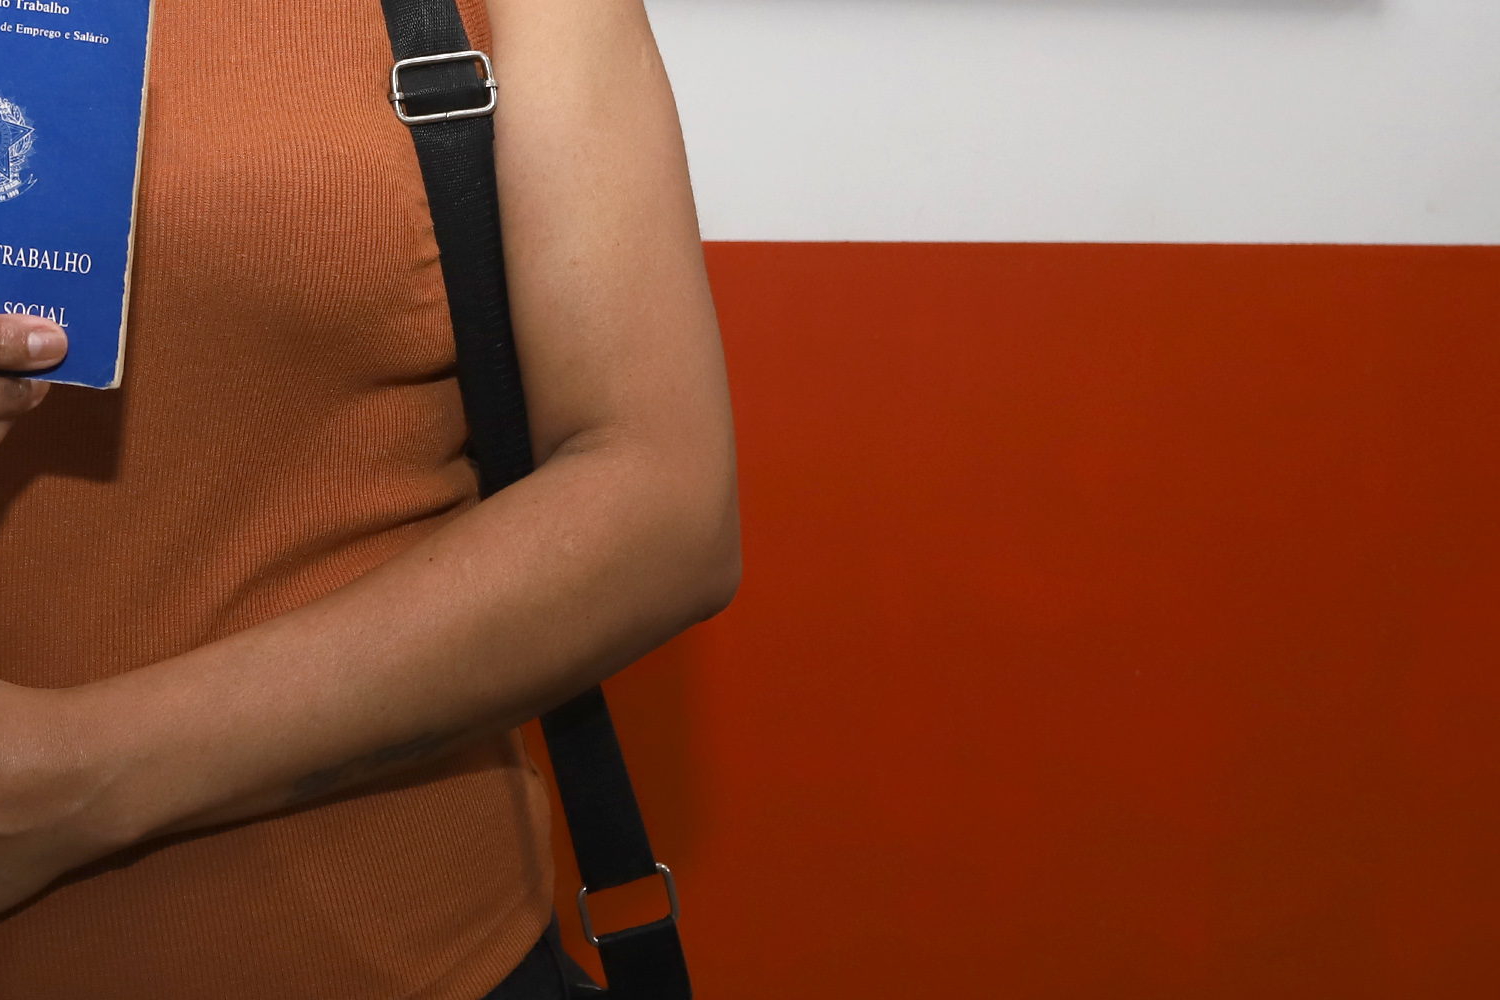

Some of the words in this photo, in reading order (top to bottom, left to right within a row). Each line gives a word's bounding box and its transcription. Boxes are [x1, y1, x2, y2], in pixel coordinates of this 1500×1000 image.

[0, 22, 13, 32] de
[16, 24, 62, 40] Emprego
[64, 31, 71, 40] e
[73, 31, 109, 45] Salário
